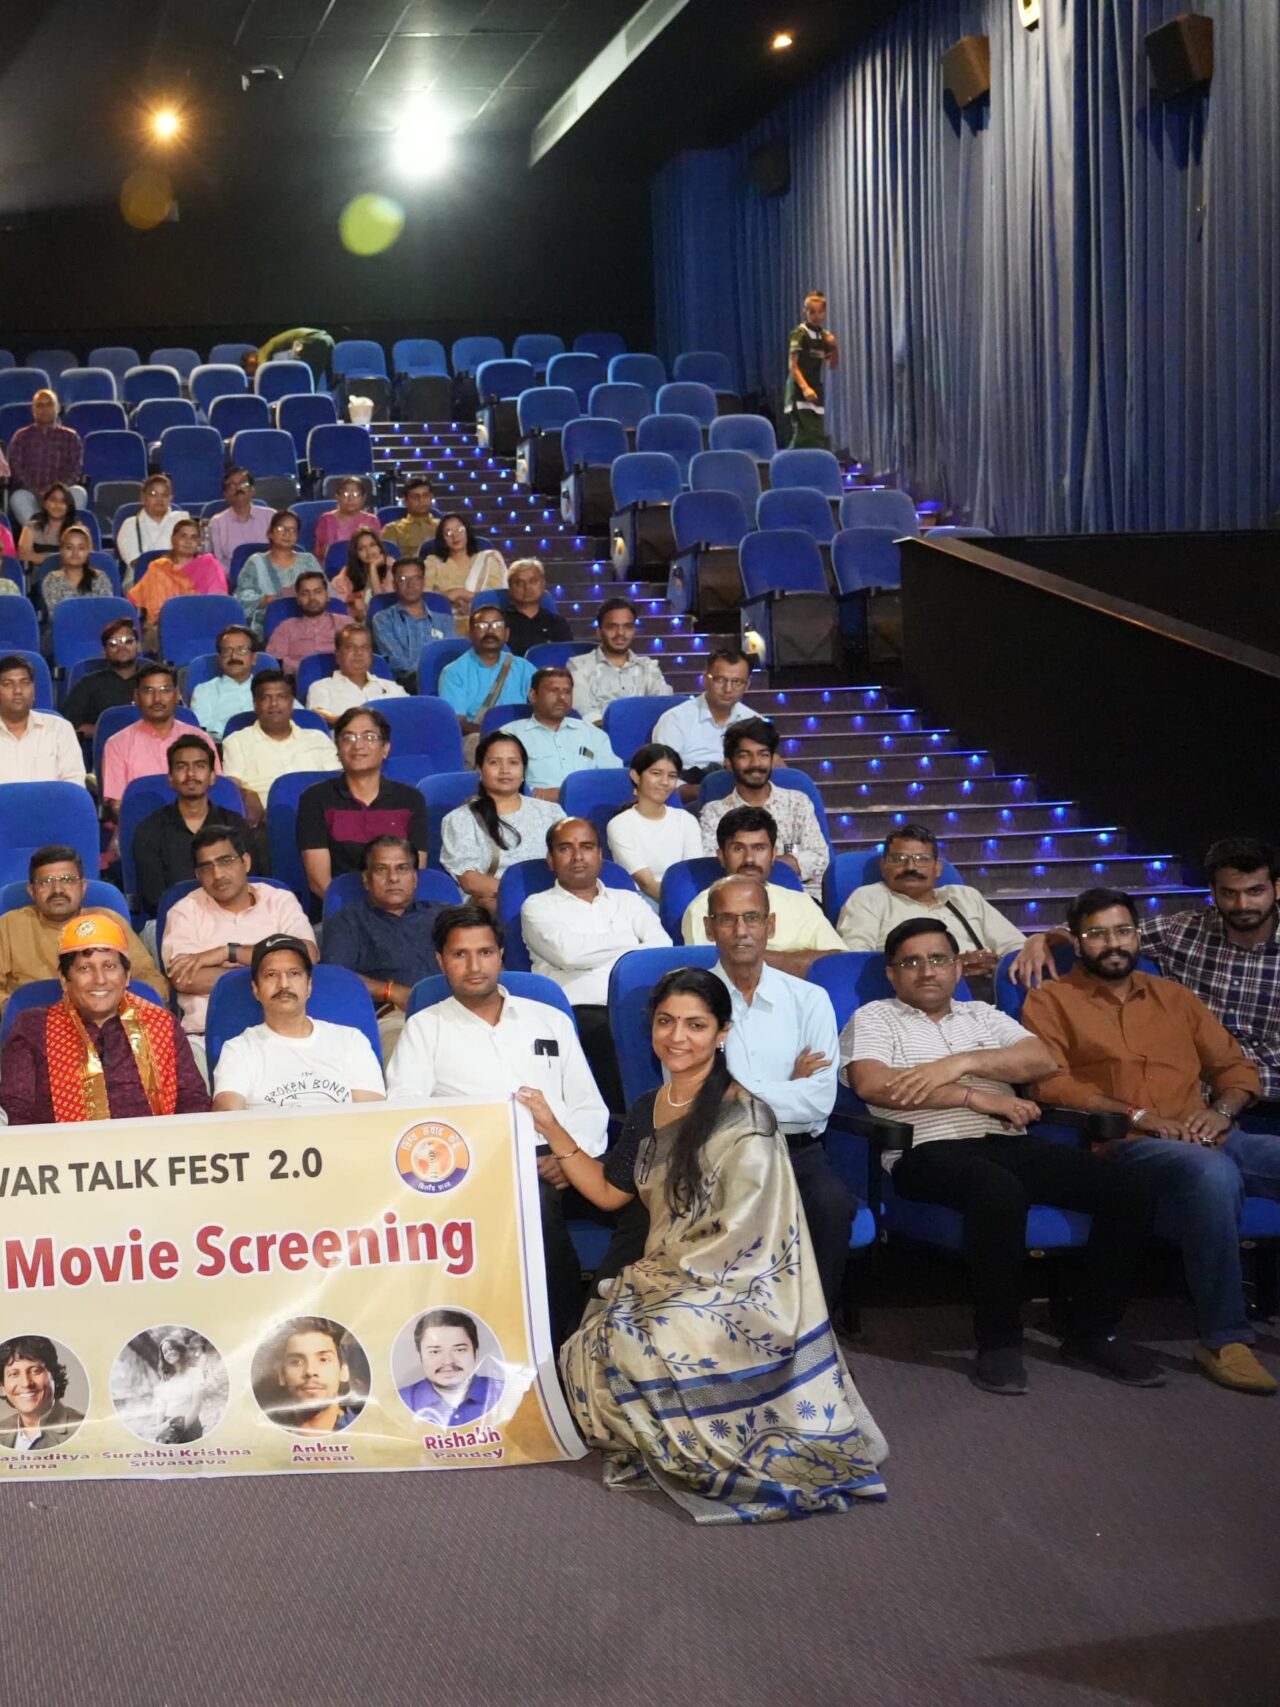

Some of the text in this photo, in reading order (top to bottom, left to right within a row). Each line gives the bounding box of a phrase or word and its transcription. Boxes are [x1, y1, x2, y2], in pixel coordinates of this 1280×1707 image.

[68, 1157, 158, 1193] TALK
[168, 1152, 250, 1186] FEST
[268, 1147, 323, 1180] 2.0
[5, 1229, 179, 1290] Movie
[195, 1211, 472, 1277] Screening
[293, 1442, 348, 1452] Ankur
[101, 1447, 252, 1459] Surabhi Krishna
[433, 1448, 502, 1459] Pandey
[130, 1459, 227, 1467] Srivastava
